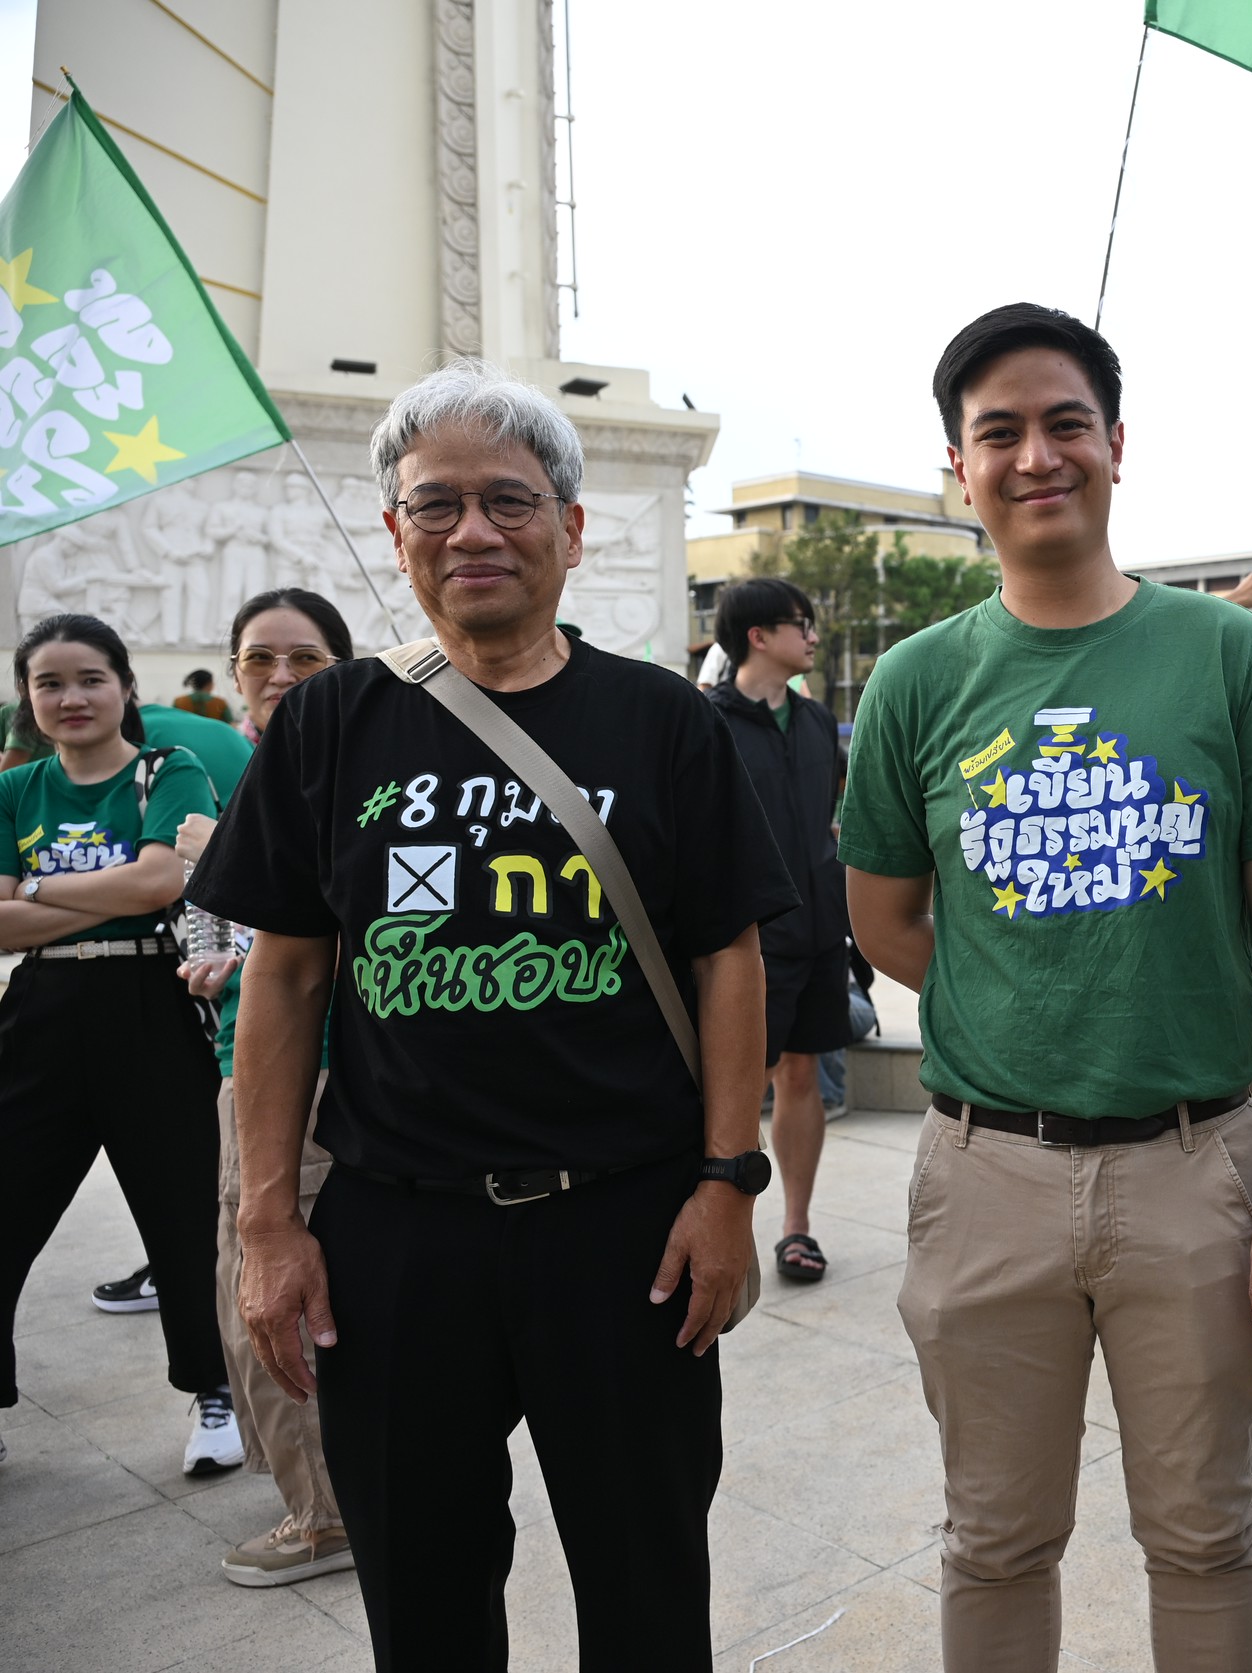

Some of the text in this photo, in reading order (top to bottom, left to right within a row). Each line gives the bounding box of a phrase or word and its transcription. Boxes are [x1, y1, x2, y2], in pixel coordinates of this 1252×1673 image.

[357, 773, 439, 829] #8
[1006, 752, 1150, 813] เขียน
[960, 803, 1205, 882] รัฐธรรมนูญ
[488, 854, 602, 918] กา
[1017, 848, 1131, 912] ใหม่
